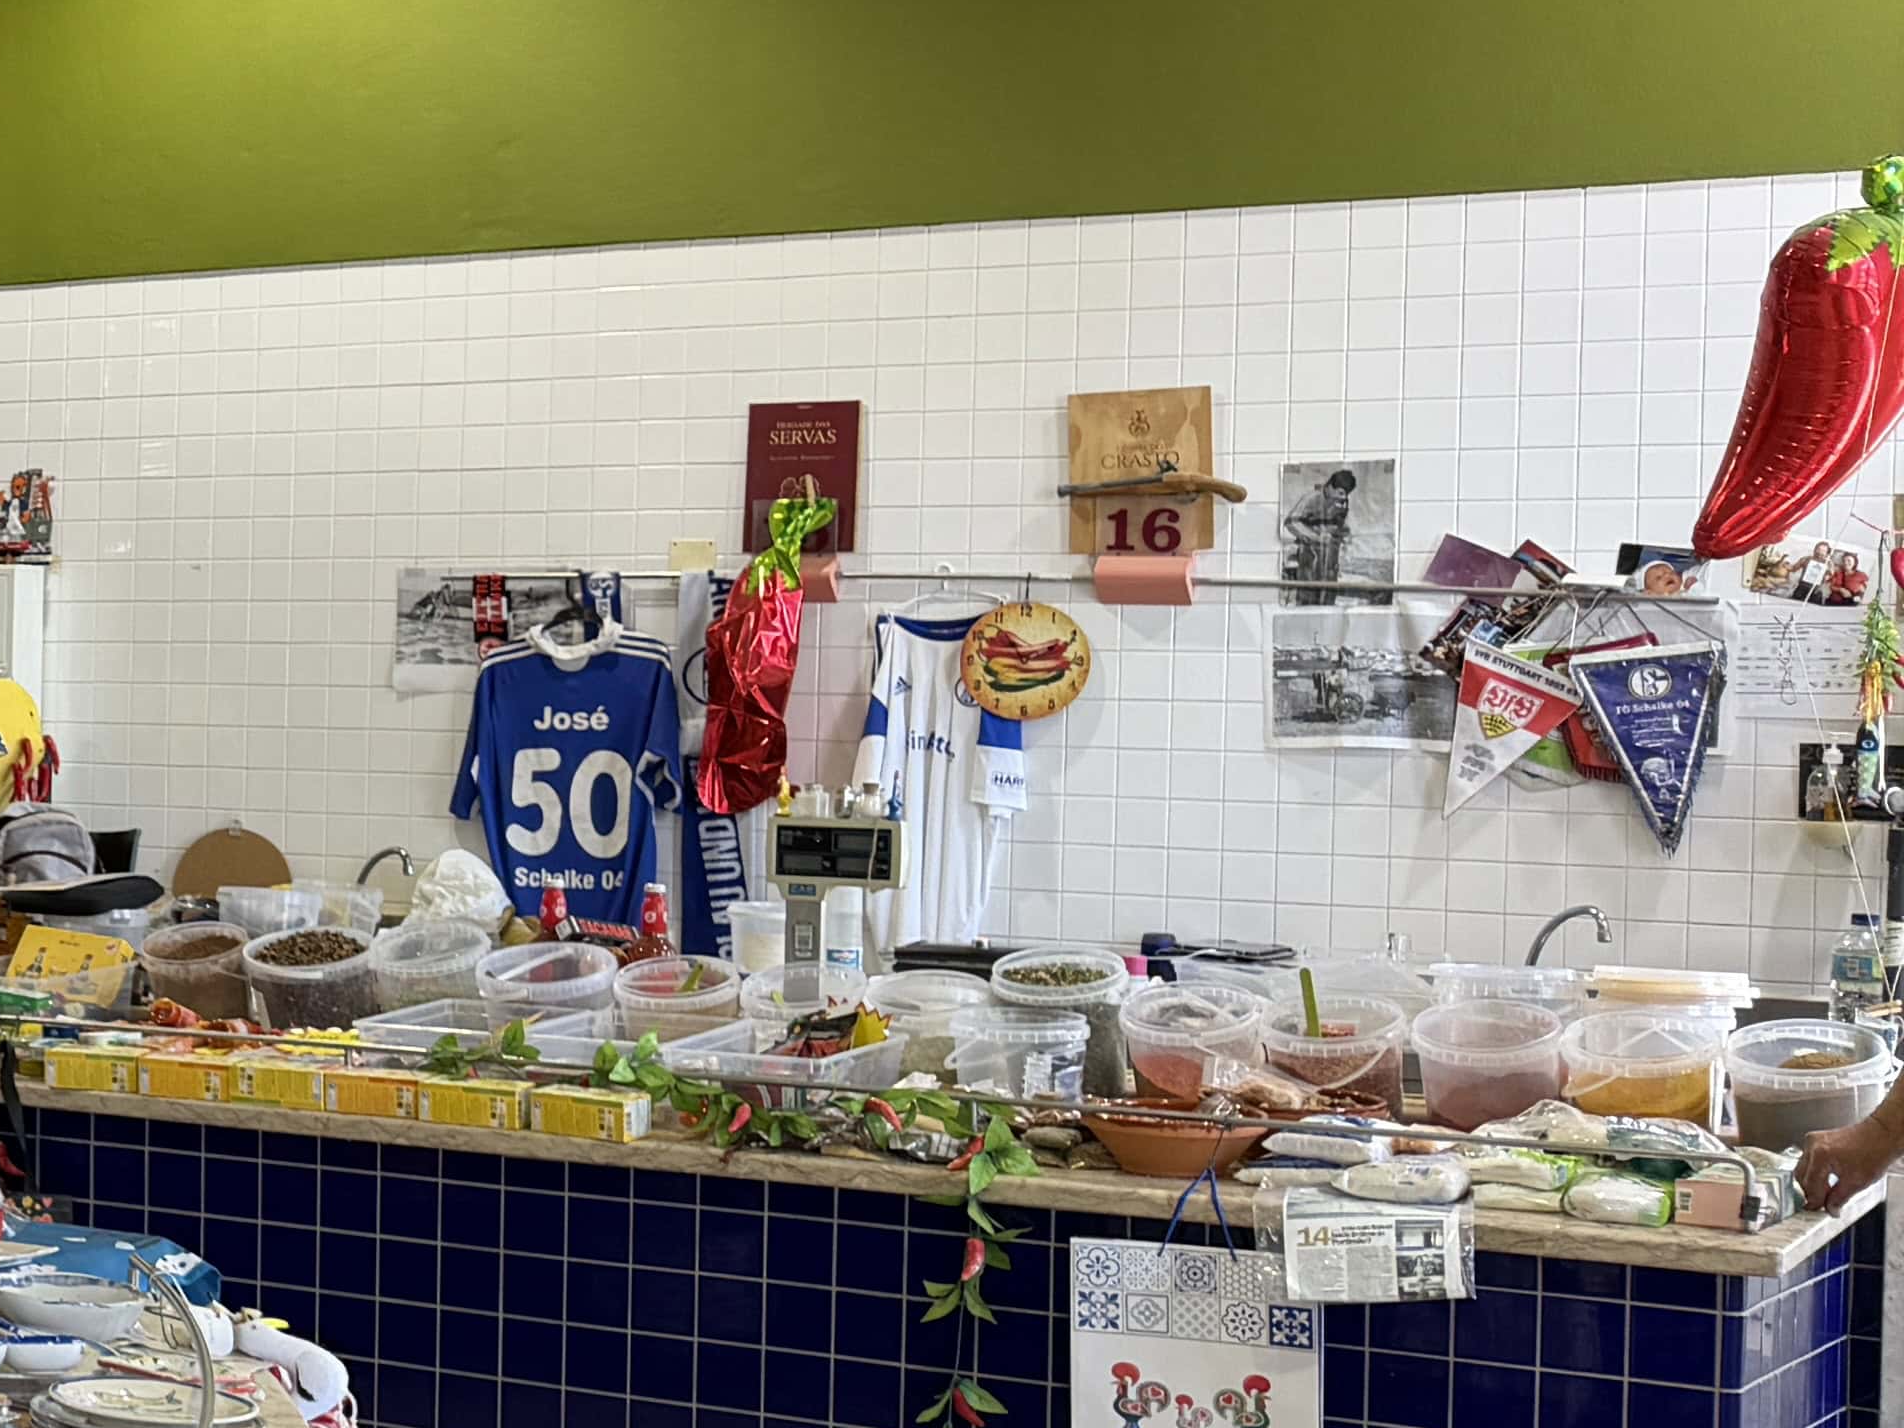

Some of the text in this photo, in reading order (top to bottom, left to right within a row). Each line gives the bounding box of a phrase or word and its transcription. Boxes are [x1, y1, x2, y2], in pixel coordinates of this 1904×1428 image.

[769, 429, 837, 445] SERVAS
[1101, 451, 1179, 469] CRASTO
[1106, 508, 1181, 552] 16
[995, 612, 1004, 623] 11
[1020, 606, 1032, 617] 12
[1492, 653, 1542, 682] STUTTGART
[1633, 701, 1673, 713] Schalke
[533, 706, 610, 731] José
[505, 747, 633, 859] 50
[699, 818, 742, 883] UND
[514, 867, 595, 890] Schalke
[1297, 1226, 1329, 1246] 14
